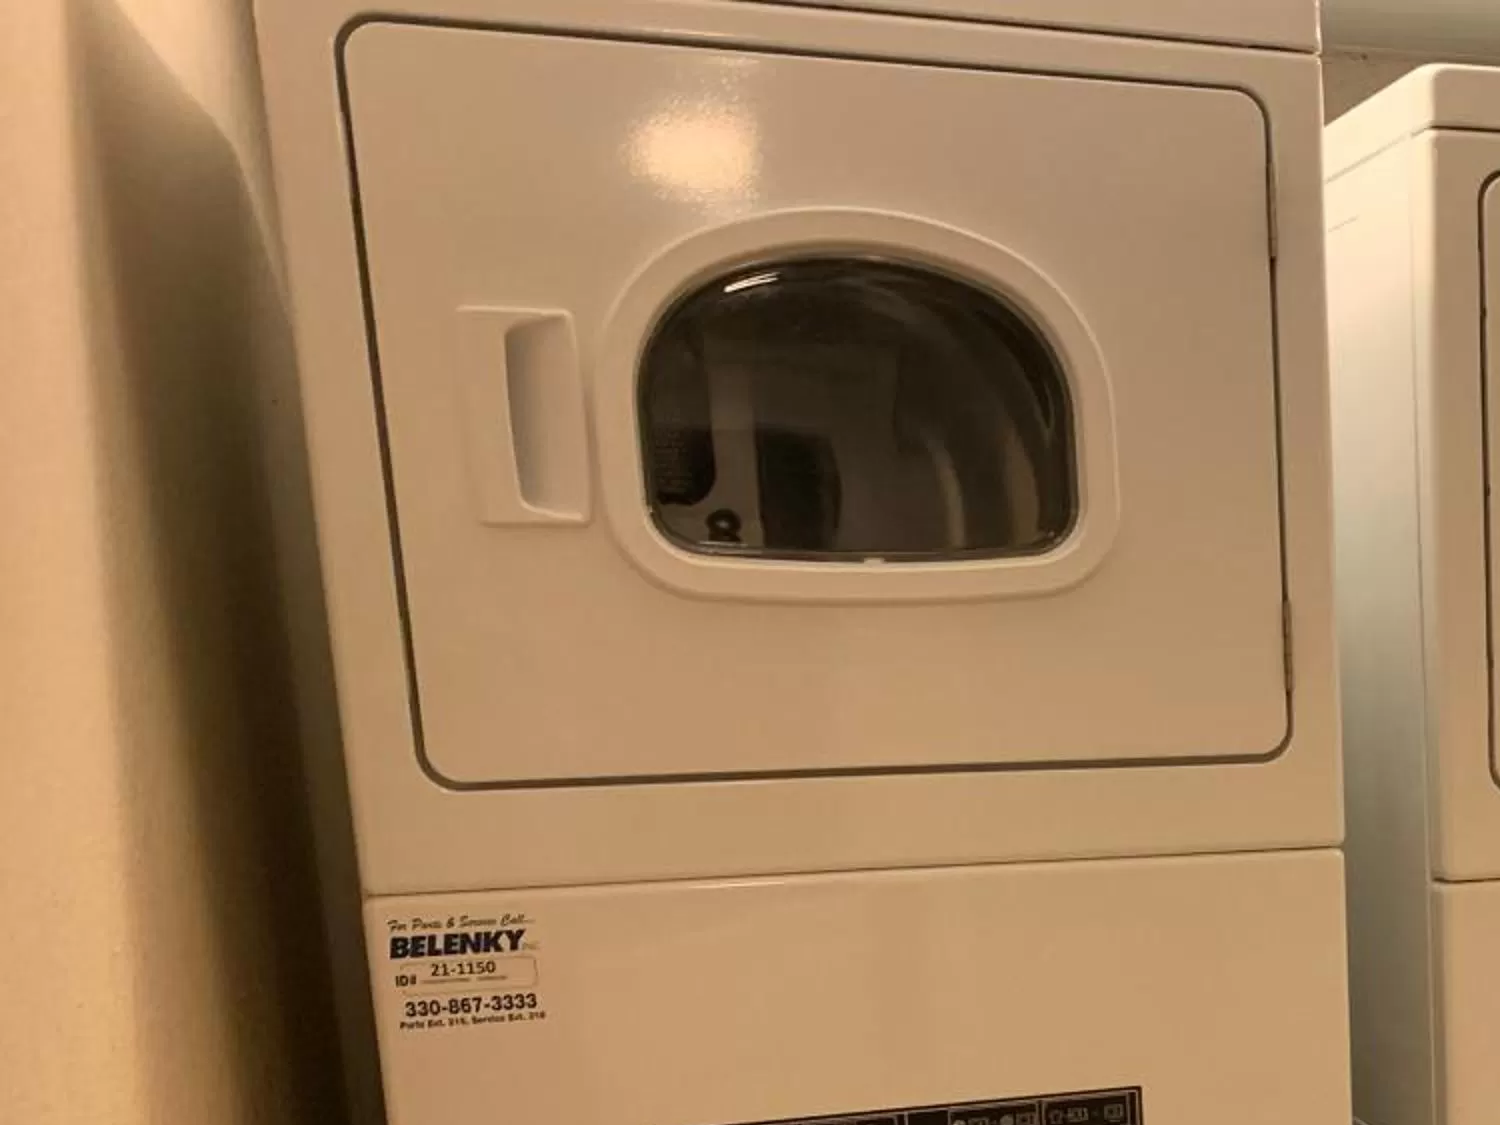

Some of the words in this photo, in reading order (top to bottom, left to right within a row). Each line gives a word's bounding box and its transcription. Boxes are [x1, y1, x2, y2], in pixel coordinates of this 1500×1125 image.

[390, 928, 526, 959] BELENKY
[430, 960, 496, 977] 21-1150
[395, 973, 417, 987] ID#
[405, 993, 537, 1018] 330-867-3333
